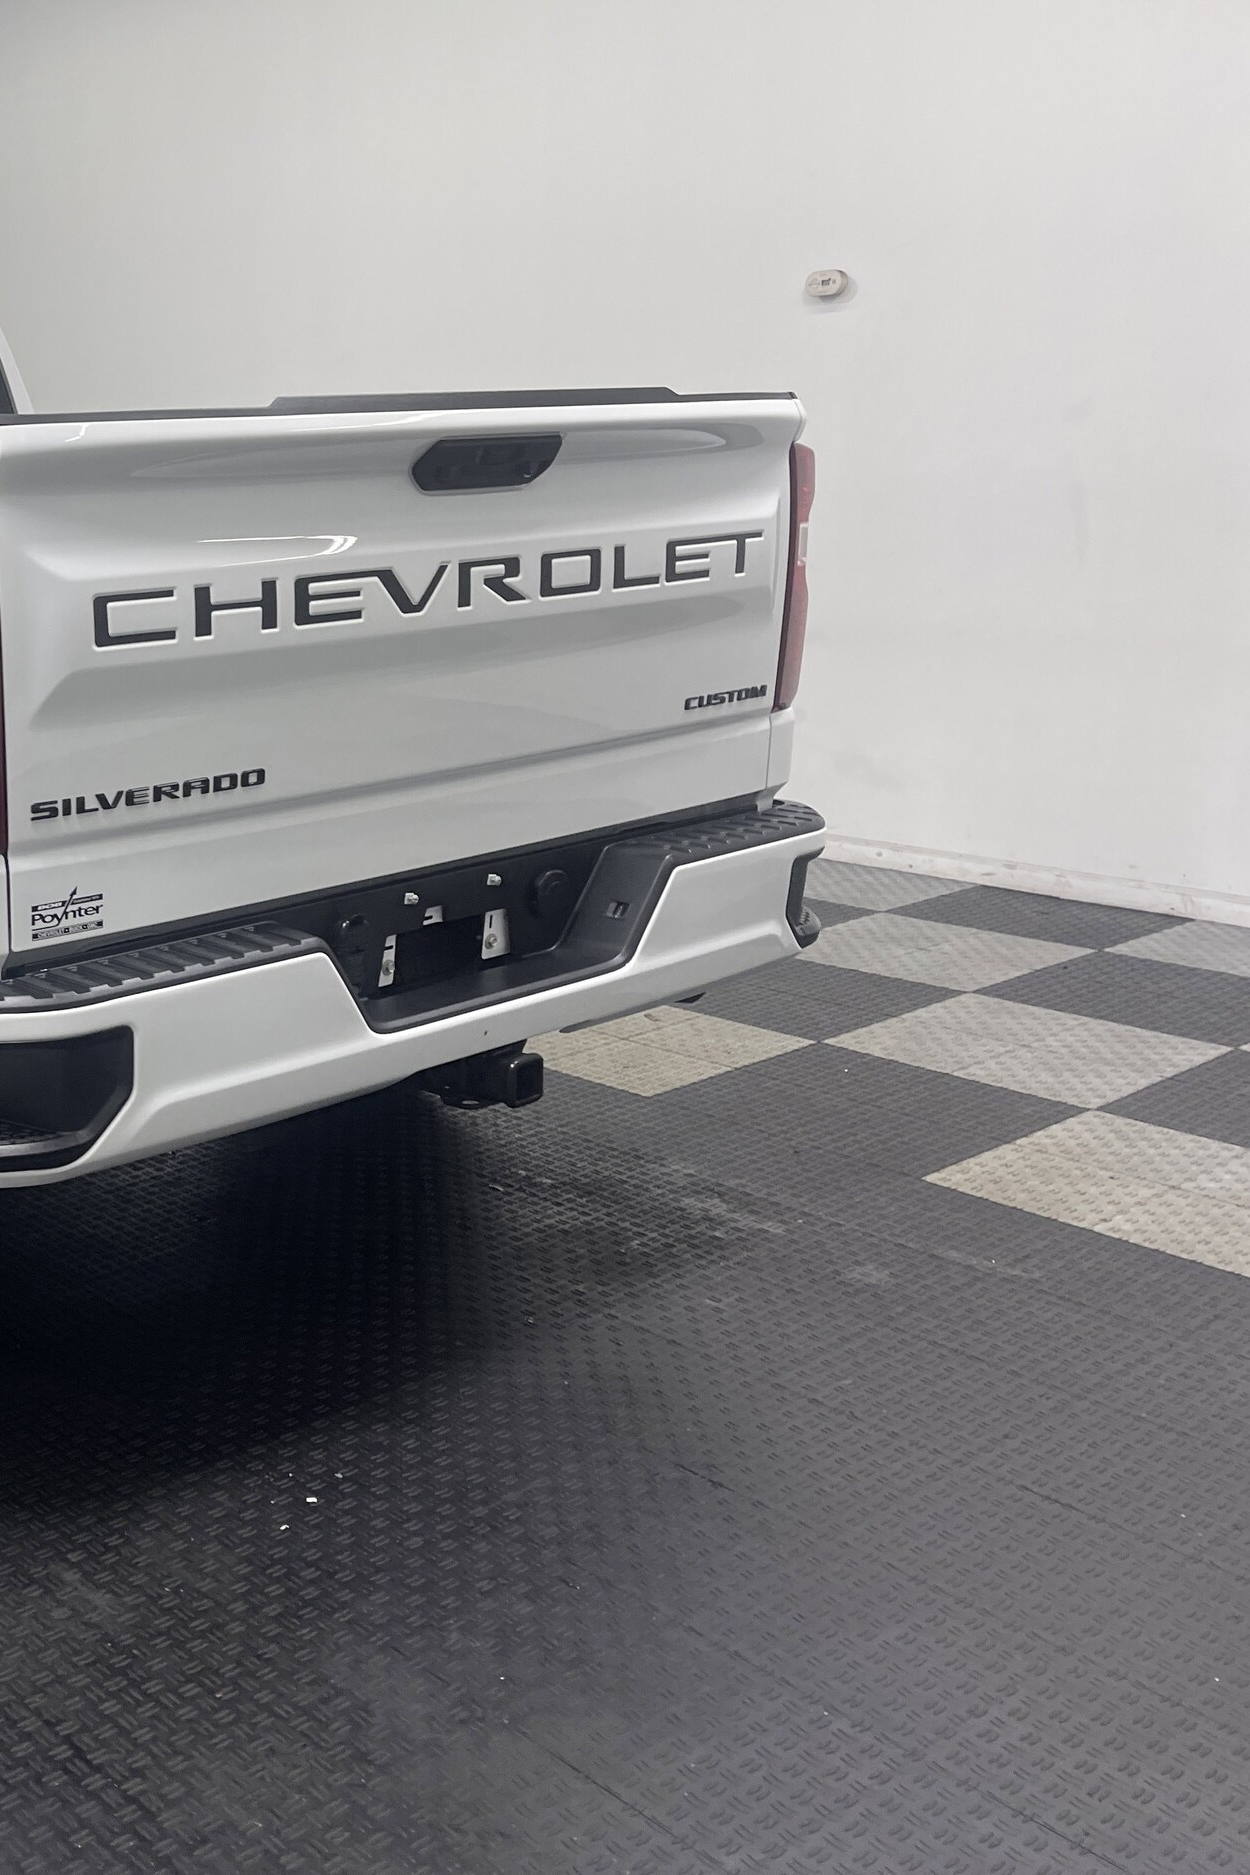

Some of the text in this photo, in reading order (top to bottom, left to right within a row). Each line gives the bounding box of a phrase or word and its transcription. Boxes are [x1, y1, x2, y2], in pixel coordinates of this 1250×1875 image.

[92, 530, 765, 648] CHEVROLET
[684, 684, 768, 711] CUSTOM
[30, 767, 266, 822] SILVERADO
[31, 904, 104, 931] Poynter
